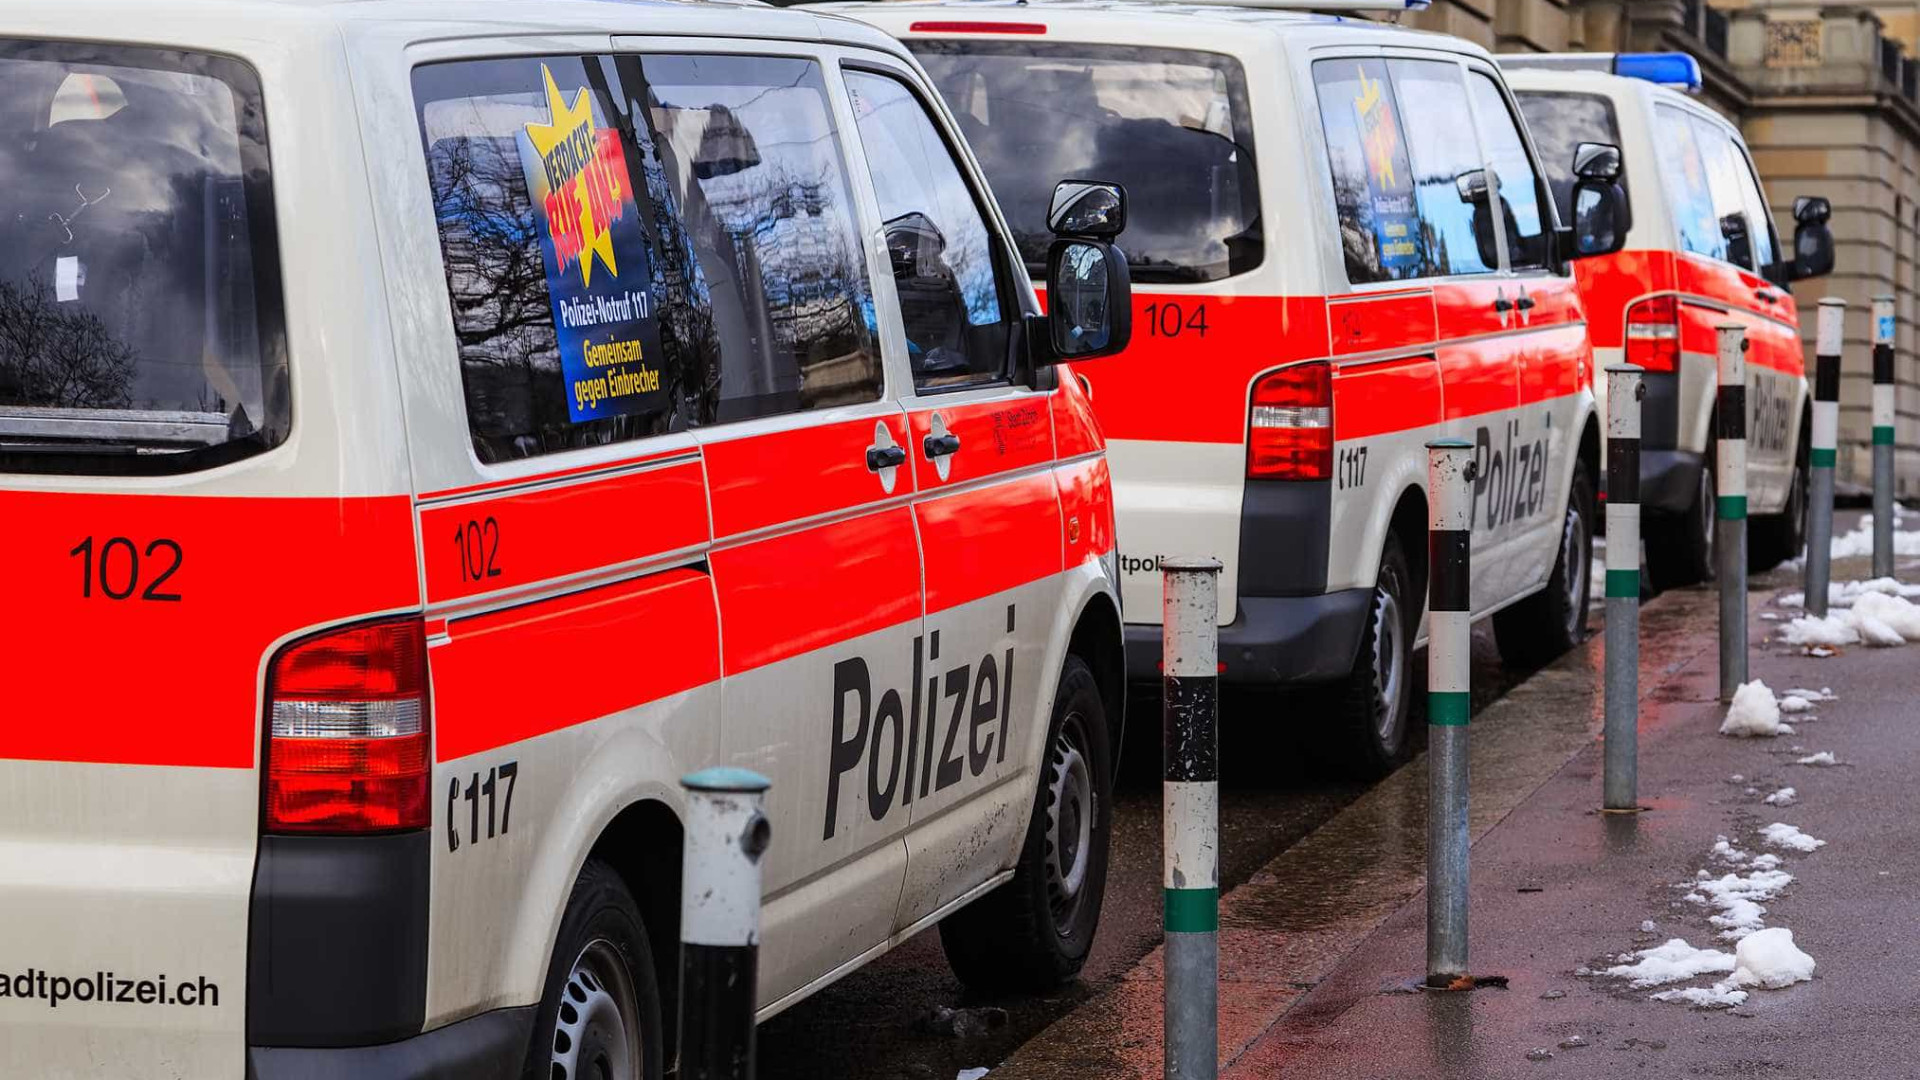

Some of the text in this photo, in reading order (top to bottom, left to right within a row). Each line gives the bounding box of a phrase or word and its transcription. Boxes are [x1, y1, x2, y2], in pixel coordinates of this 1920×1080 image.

[545, 134, 623, 277] RUF AN!
[560, 291, 648, 328] Polizei-Notruf 117
[1144, 302, 1211, 338] 104
[583, 334, 643, 368] Gemeinsam
[574, 363, 660, 411] gegen Einbrecher
[1346, 446, 1367, 488] 117
[1470, 411, 1550, 535] Polizei
[70, 536, 182, 602] 102
[454, 516, 502, 582] 102
[823, 603, 1015, 841] Polizei
[465, 761, 518, 845] 117
[0, 968, 219, 1008] adtpolizei.ch
